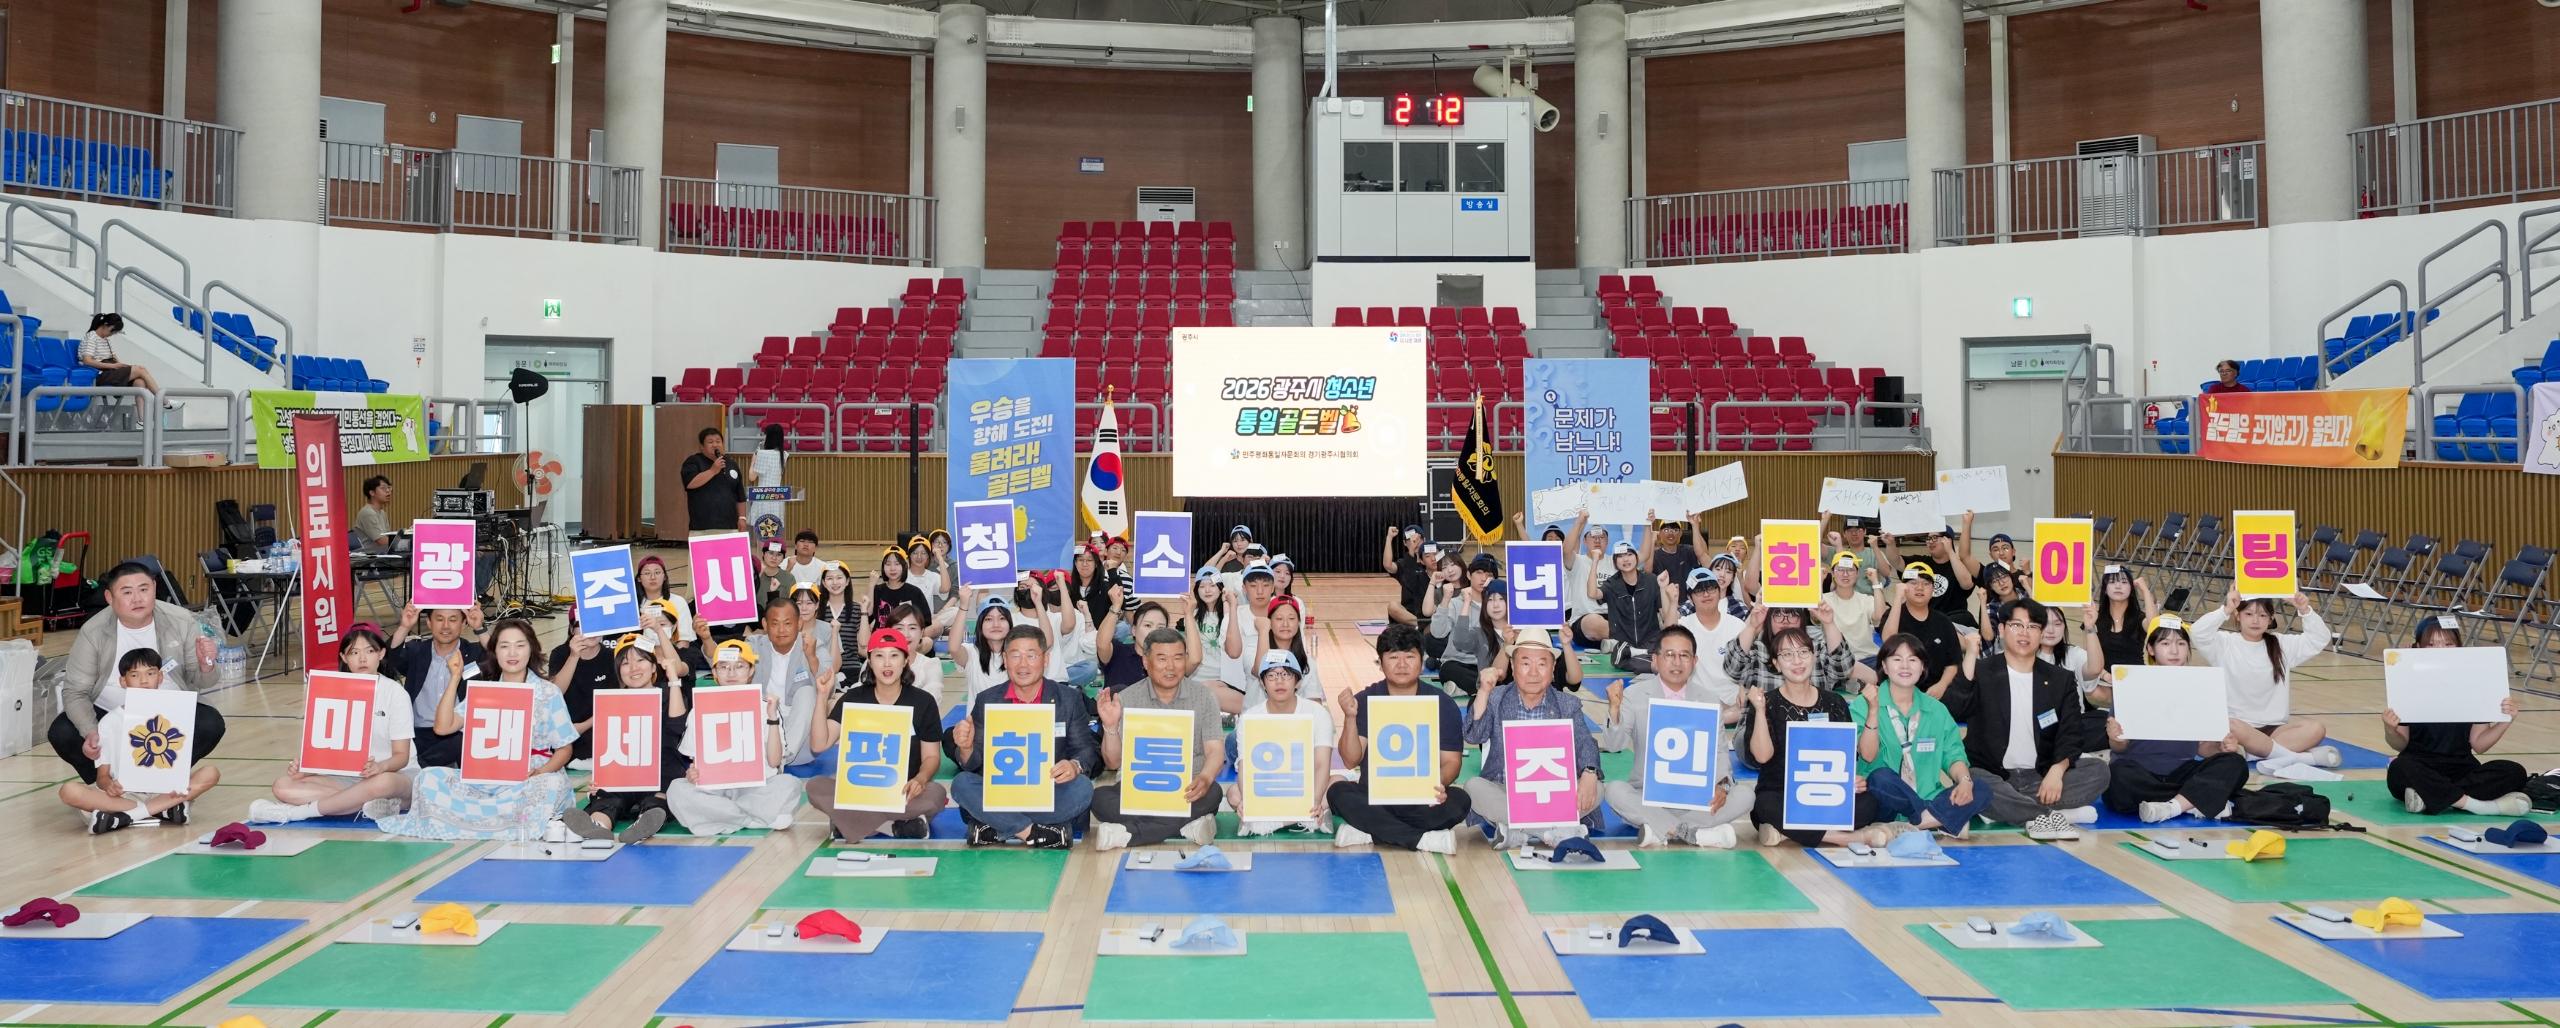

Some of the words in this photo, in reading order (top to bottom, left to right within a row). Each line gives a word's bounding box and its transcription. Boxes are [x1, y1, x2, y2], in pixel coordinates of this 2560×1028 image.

[1396, 97, 1411, 123] 2
[1435, 97, 1461, 123] 12
[1465, 200, 1494, 209] 방송실
[2010, 360, 2023, 368] 남문
[1222, 377, 1272, 400] 2026
[1272, 376, 1325, 400] 광주시
[1324, 375, 1377, 400] 청소년
[344, 409, 374, 429] 민통선을
[969, 396, 1031, 425] 우승을
[973, 423, 1008, 447] 향해
[1013, 414, 1054, 439] 도전!
[1235, 407, 1341, 435] 통일골든벨
[1553, 407, 1616, 430] 문제가
[2206, 412, 2250, 444] 골든벨은
[2251, 413, 2309, 447] 곤지암고가
[2311, 414, 2353, 447] 울린다!
[969, 440, 1041, 476] 울려라!
[1242, 450, 1306, 459] 민주평화통일자문회의
[1554, 431, 1622, 453] 남느냐!
[987, 463, 1052, 499] 골든벨
[1567, 454, 1609, 476] 내가
[305, 443, 339, 645] 의료지원
[419, 543, 471, 590] 광
[962, 522, 1010, 570] 청
[1140, 534, 1186, 578] 소
[1767, 541, 1816, 586] 화
[2040, 541, 2085, 586] 이
[2242, 533, 2289, 578] 팅
[582, 567, 632, 616] 주
[700, 556, 749, 605] 시
[1513, 563, 1559, 610] 년
[310, 698, 367, 752] 미
[470, 708, 526, 762] 래
[600, 715, 653, 767] 세
[701, 711, 756, 765] 대
[845, 731, 902, 788] 평
[991, 731, 1048, 786] 화
[1131, 737, 1185, 792] 통
[1251, 742, 1304, 797] 일
[1376, 723, 1430, 777] 의
[1653, 727, 1709, 787] 인
[1514, 747, 1570, 804] 주
[1793, 749, 1850, 807] 공
